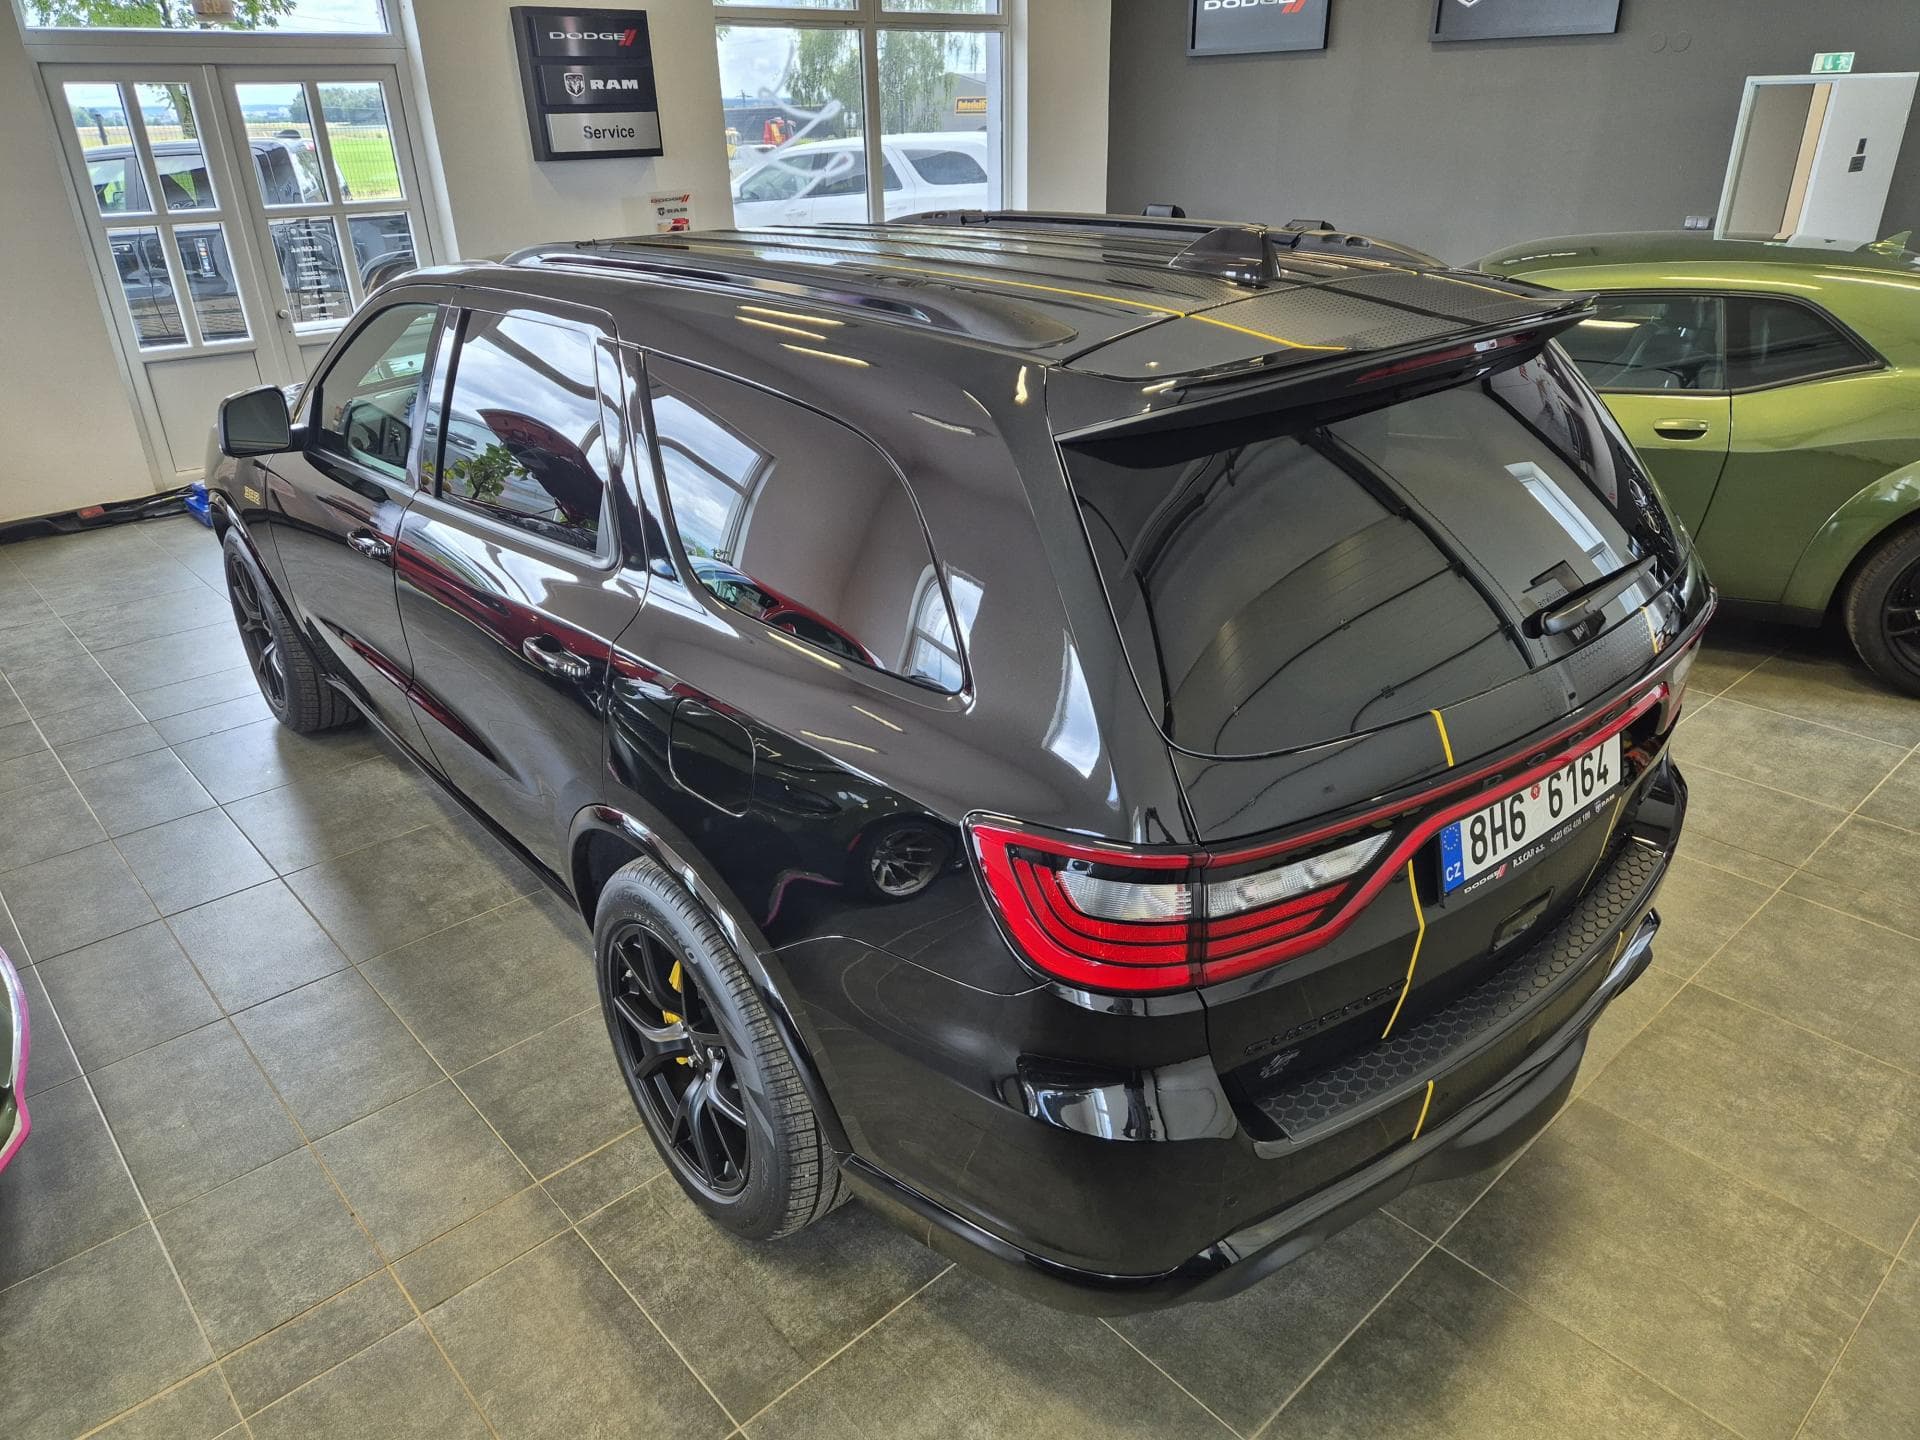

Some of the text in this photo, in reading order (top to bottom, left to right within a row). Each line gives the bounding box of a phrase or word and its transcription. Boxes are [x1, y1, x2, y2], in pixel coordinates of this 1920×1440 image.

[549, 31, 626, 41] DODGE
[589, 79, 639, 90] RAM
[583, 125, 635, 140] Service
[1469, 744, 1609, 866] 8H6 6164
[1445, 861, 1463, 883] CZ
